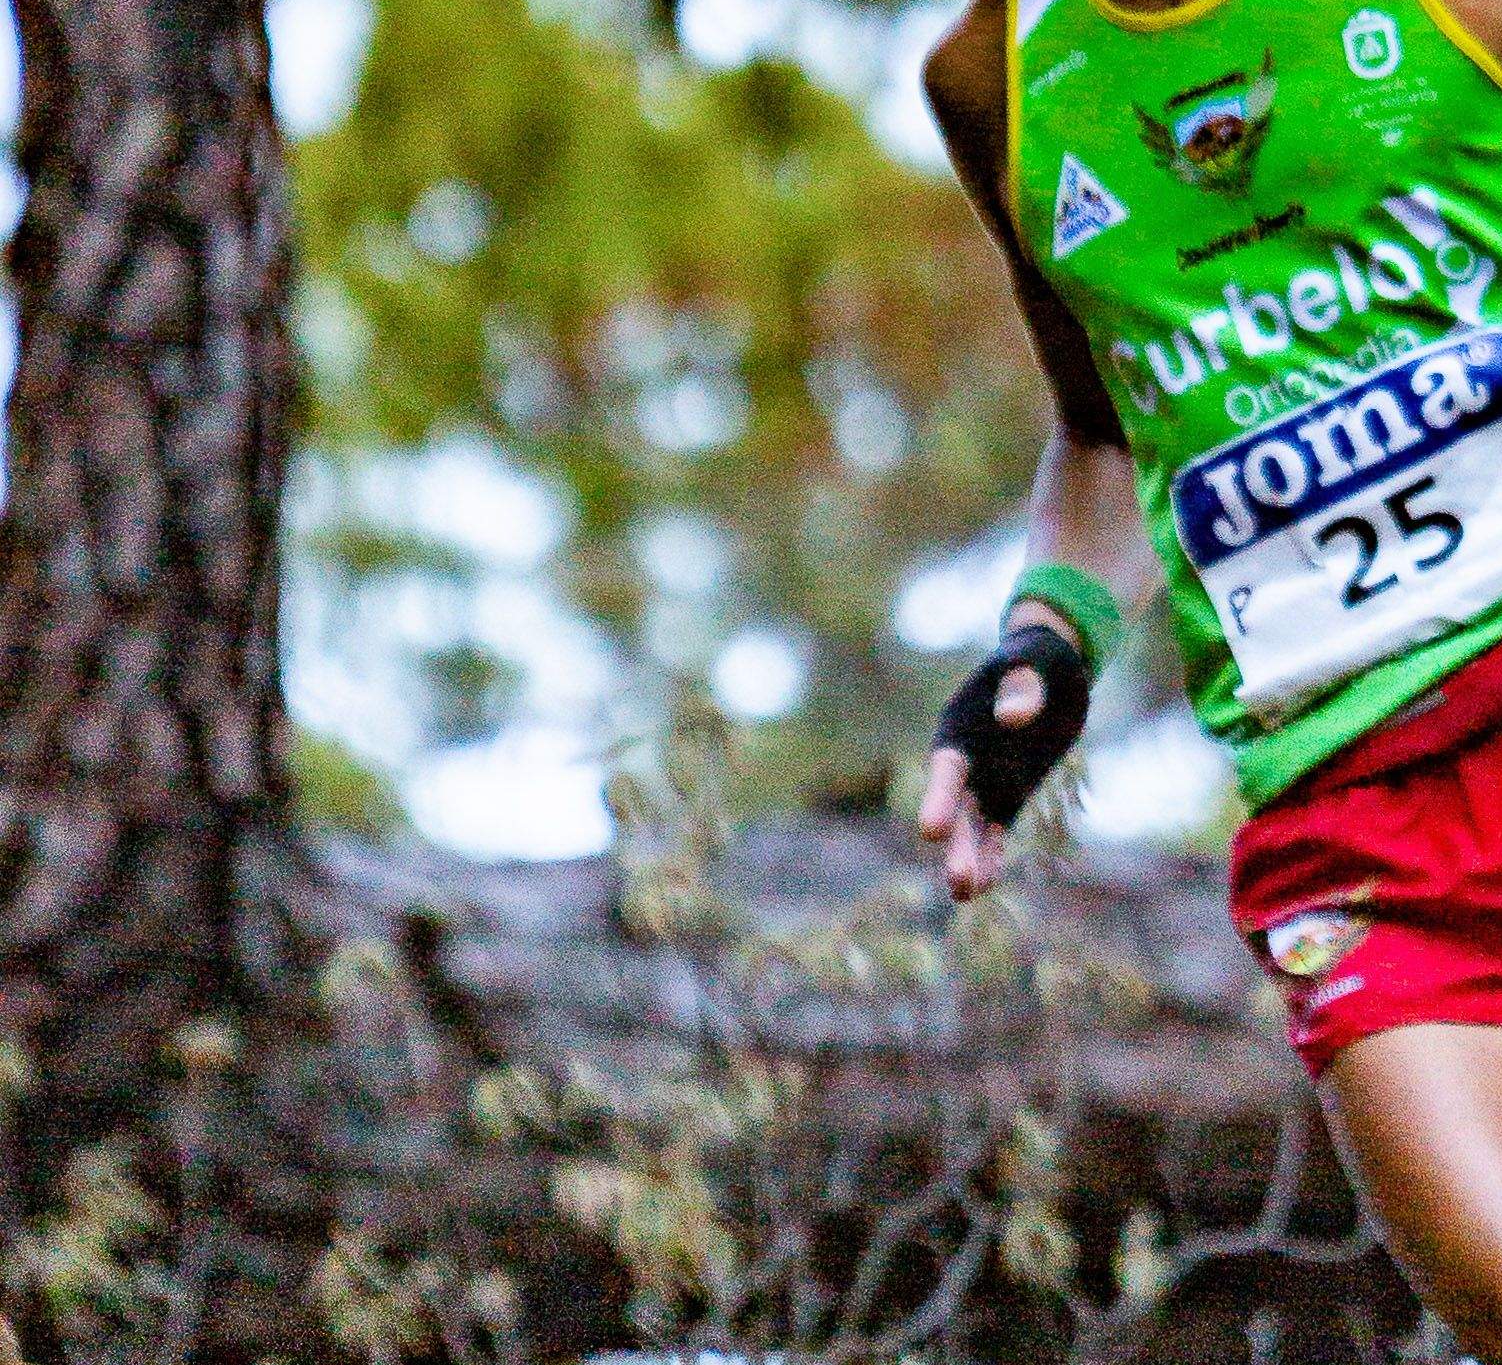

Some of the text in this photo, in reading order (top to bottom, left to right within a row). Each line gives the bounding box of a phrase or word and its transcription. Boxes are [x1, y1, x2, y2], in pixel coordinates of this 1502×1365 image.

[1225, 328, 1419, 426] Ortopdia
[1203, 355, 1491, 545] Joma
[1313, 475, 1464, 610] 25
